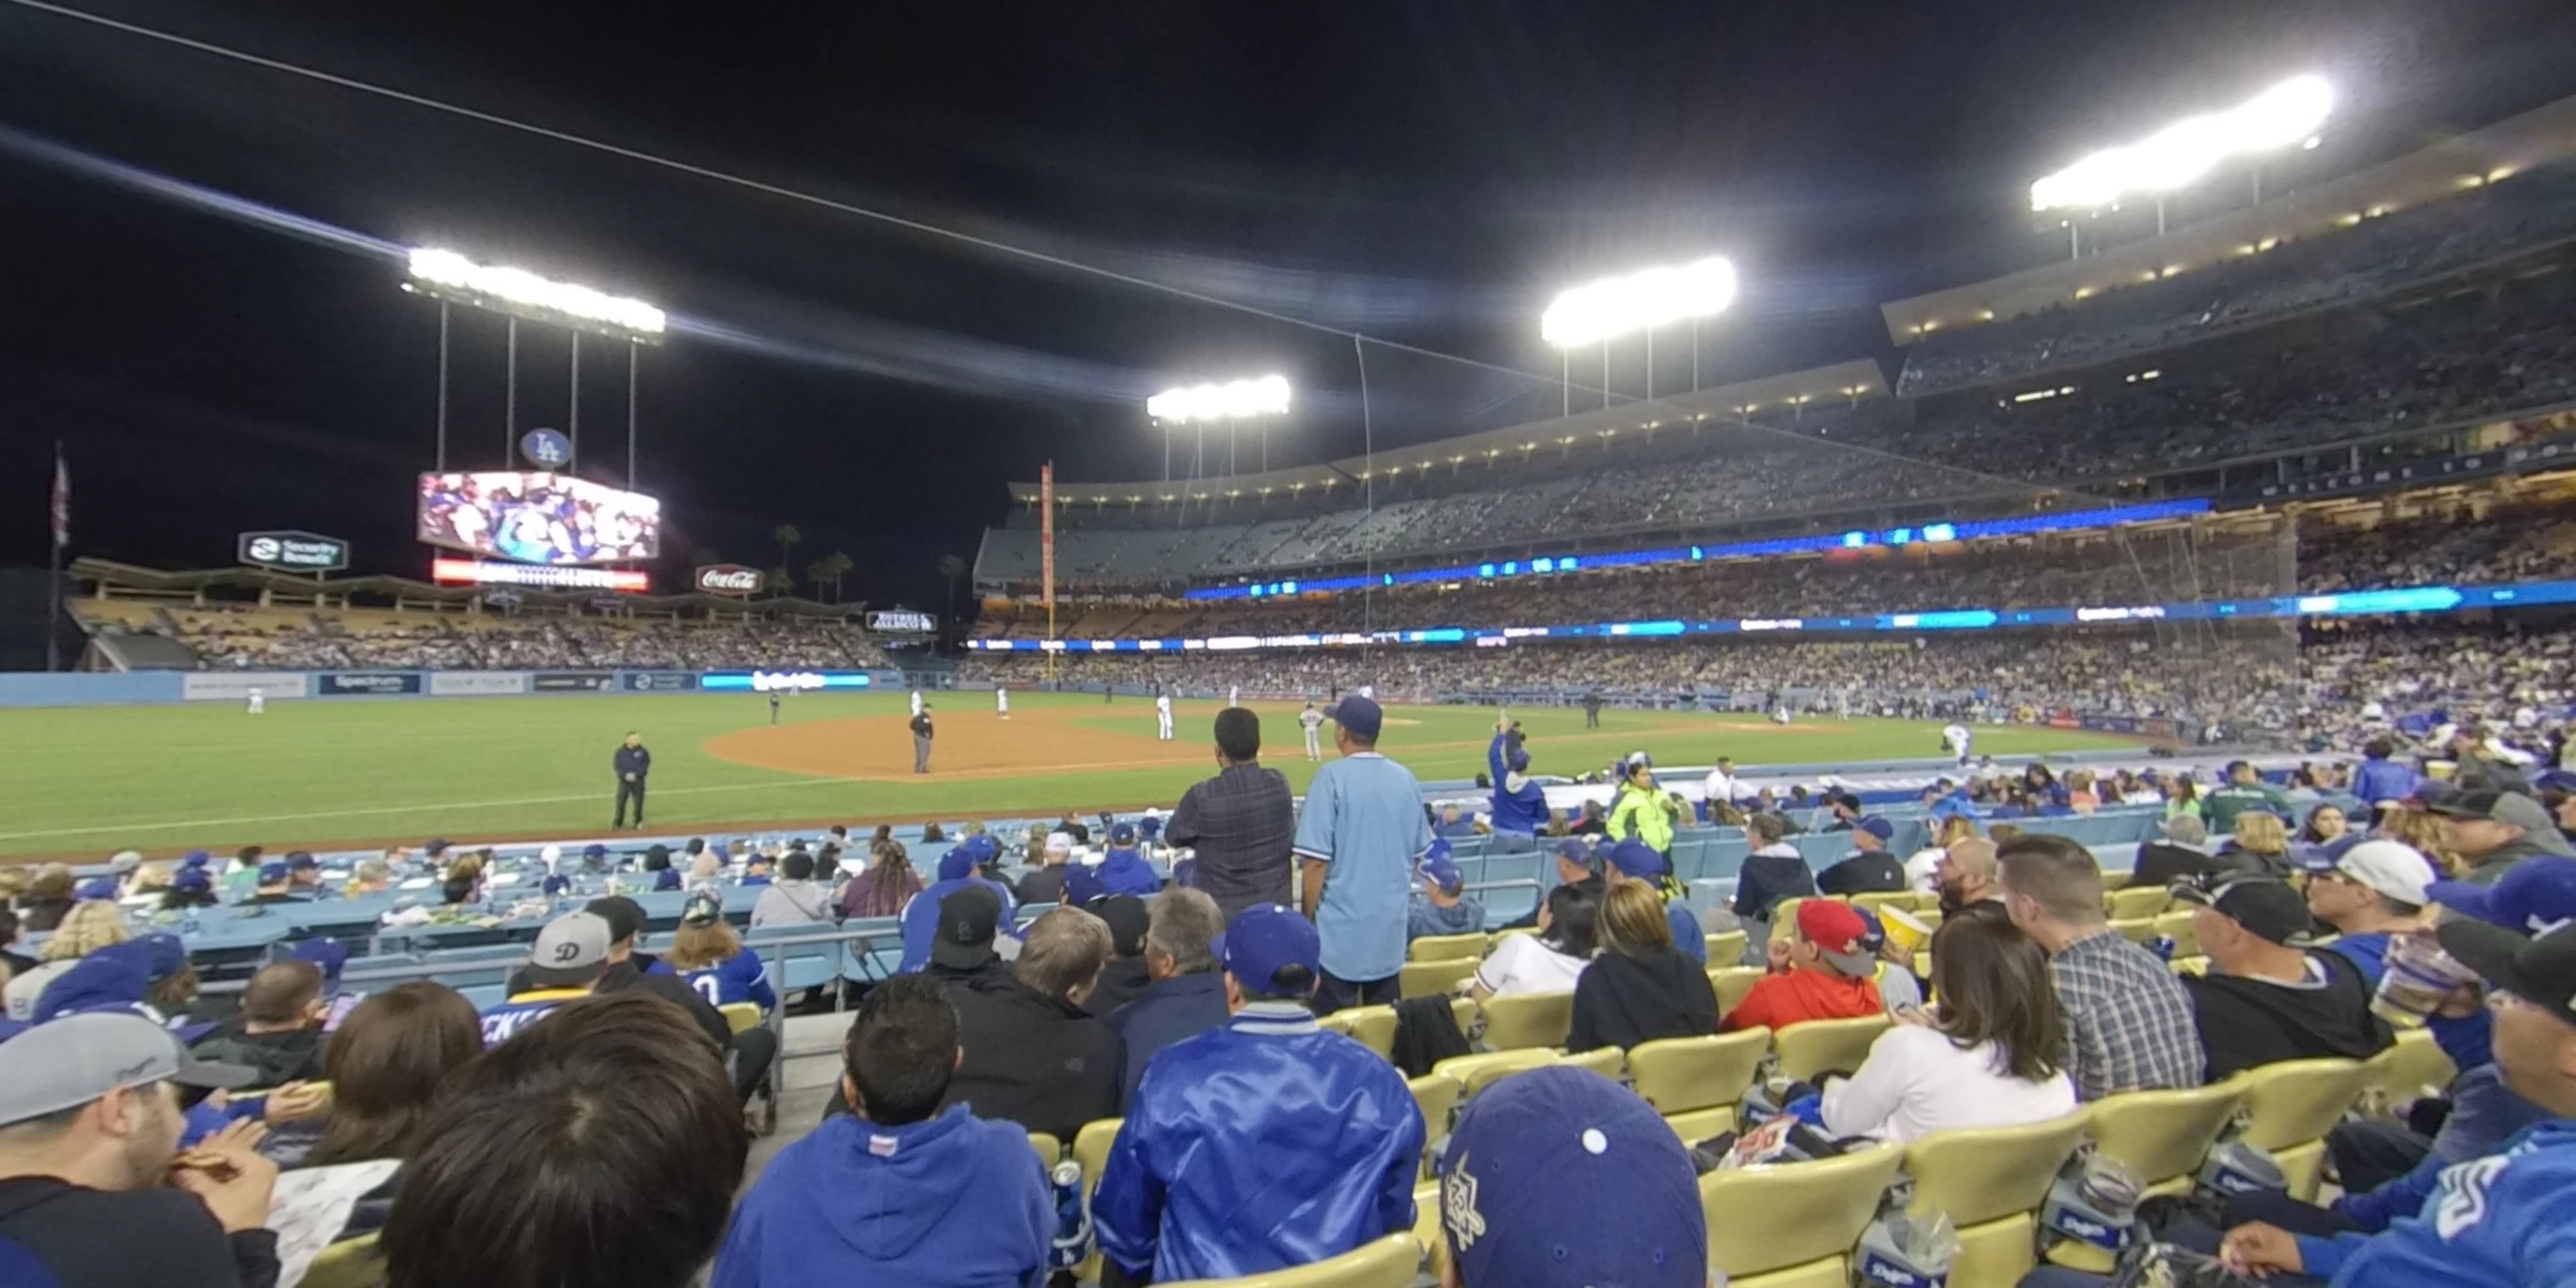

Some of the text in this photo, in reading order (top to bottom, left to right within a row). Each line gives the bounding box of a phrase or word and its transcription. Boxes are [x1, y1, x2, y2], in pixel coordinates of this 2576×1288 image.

[536, 433, 559, 462] LA
[284, 540, 340, 554] Security
[335, 675, 402, 687] Spectrum
[555, 941, 580, 961] D
